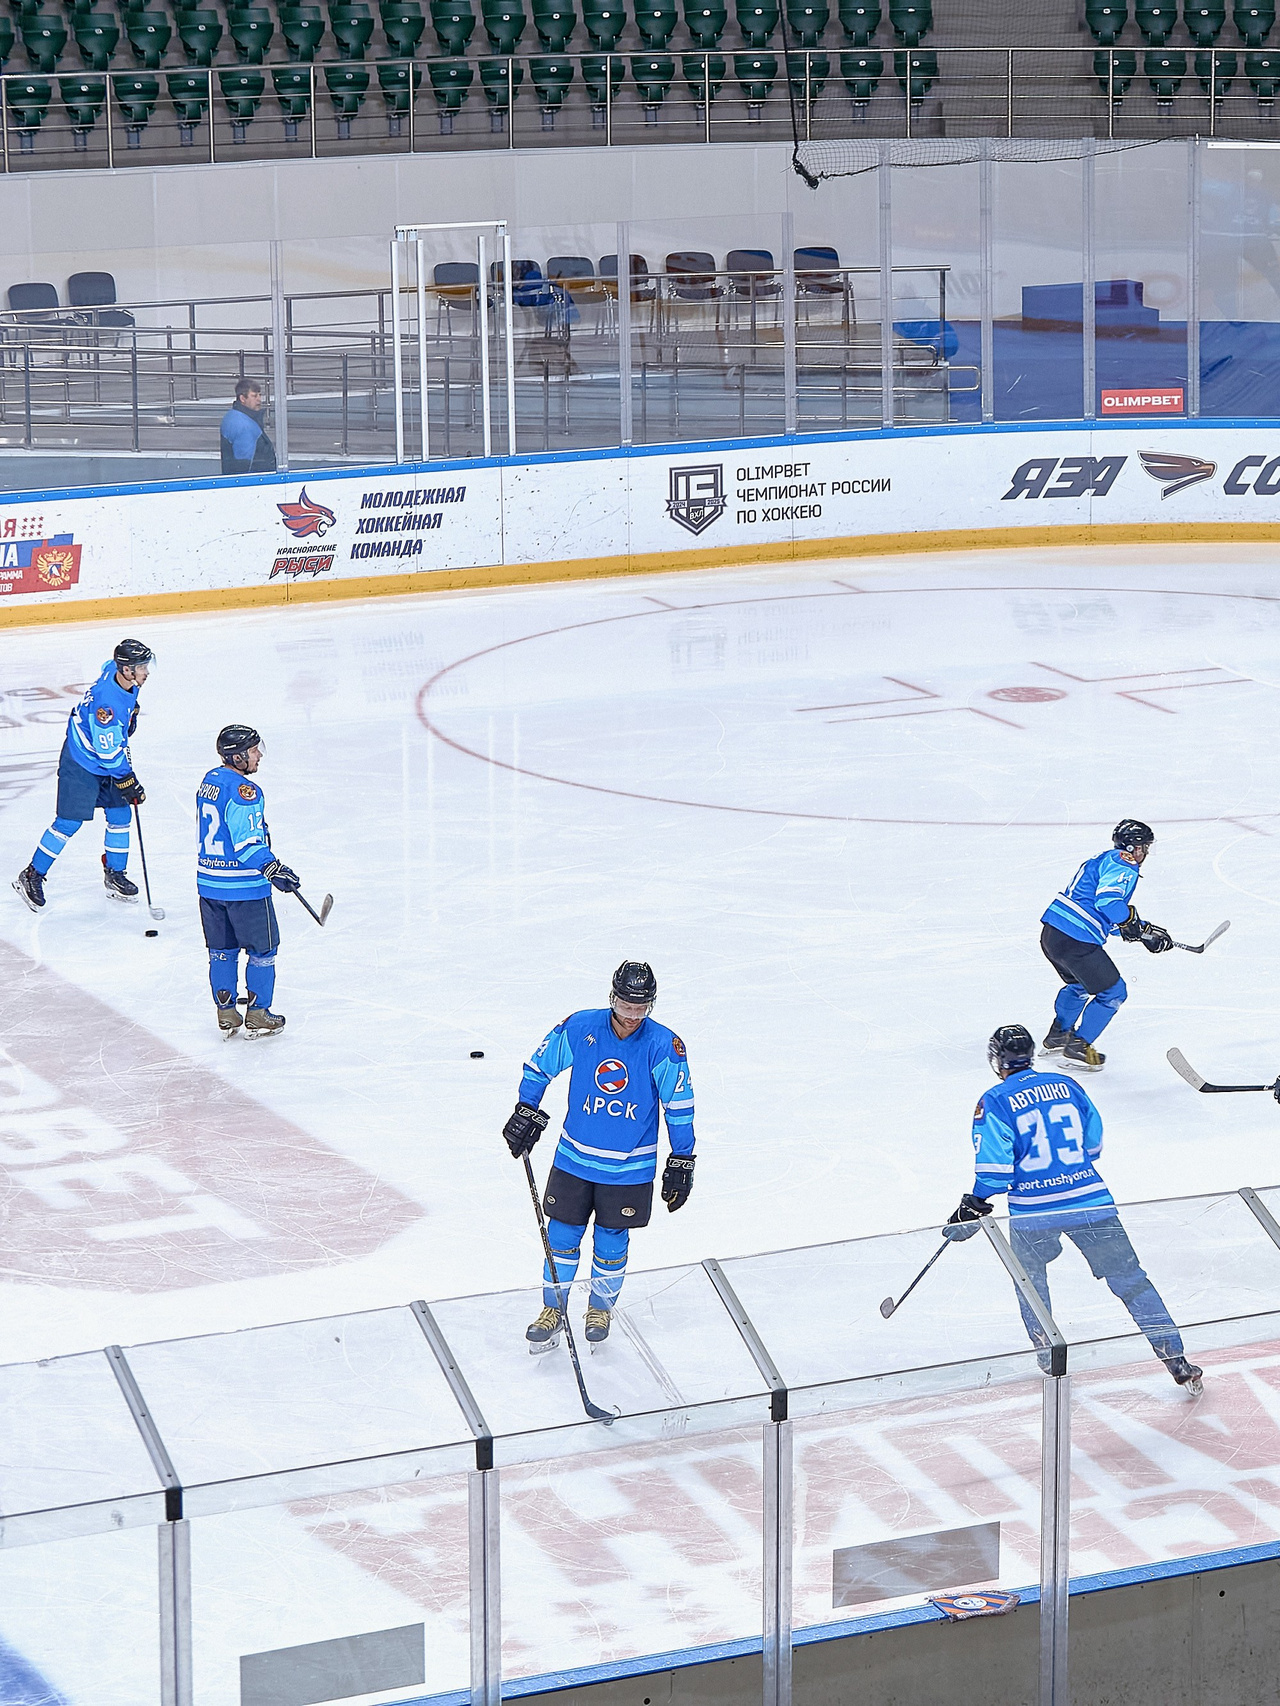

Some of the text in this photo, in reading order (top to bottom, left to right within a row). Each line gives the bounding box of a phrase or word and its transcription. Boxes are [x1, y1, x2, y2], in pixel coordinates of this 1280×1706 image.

[1104, 394, 1181, 407] OLIMPBET
[736, 462, 811, 481] OLIMPBET
[360, 486, 466, 509] МОЛОДЕЖНАЯ
[736, 478, 891, 502] ЧЕМПИОНАТ РОССИИ
[355, 511, 443, 535] ХОККЕЙНАЯ
[736, 504, 822, 524] ПО ХОККЕЮ
[277, 544, 338, 555] КРАСНОЯРСКИЕ
[350, 538, 423, 559] КОМАНДА
[269, 554, 335, 580] РЫСИ
[1008, 1083, 1071, 1112] АВТУШКО
[1016, 1103, 1084, 1172] 33
